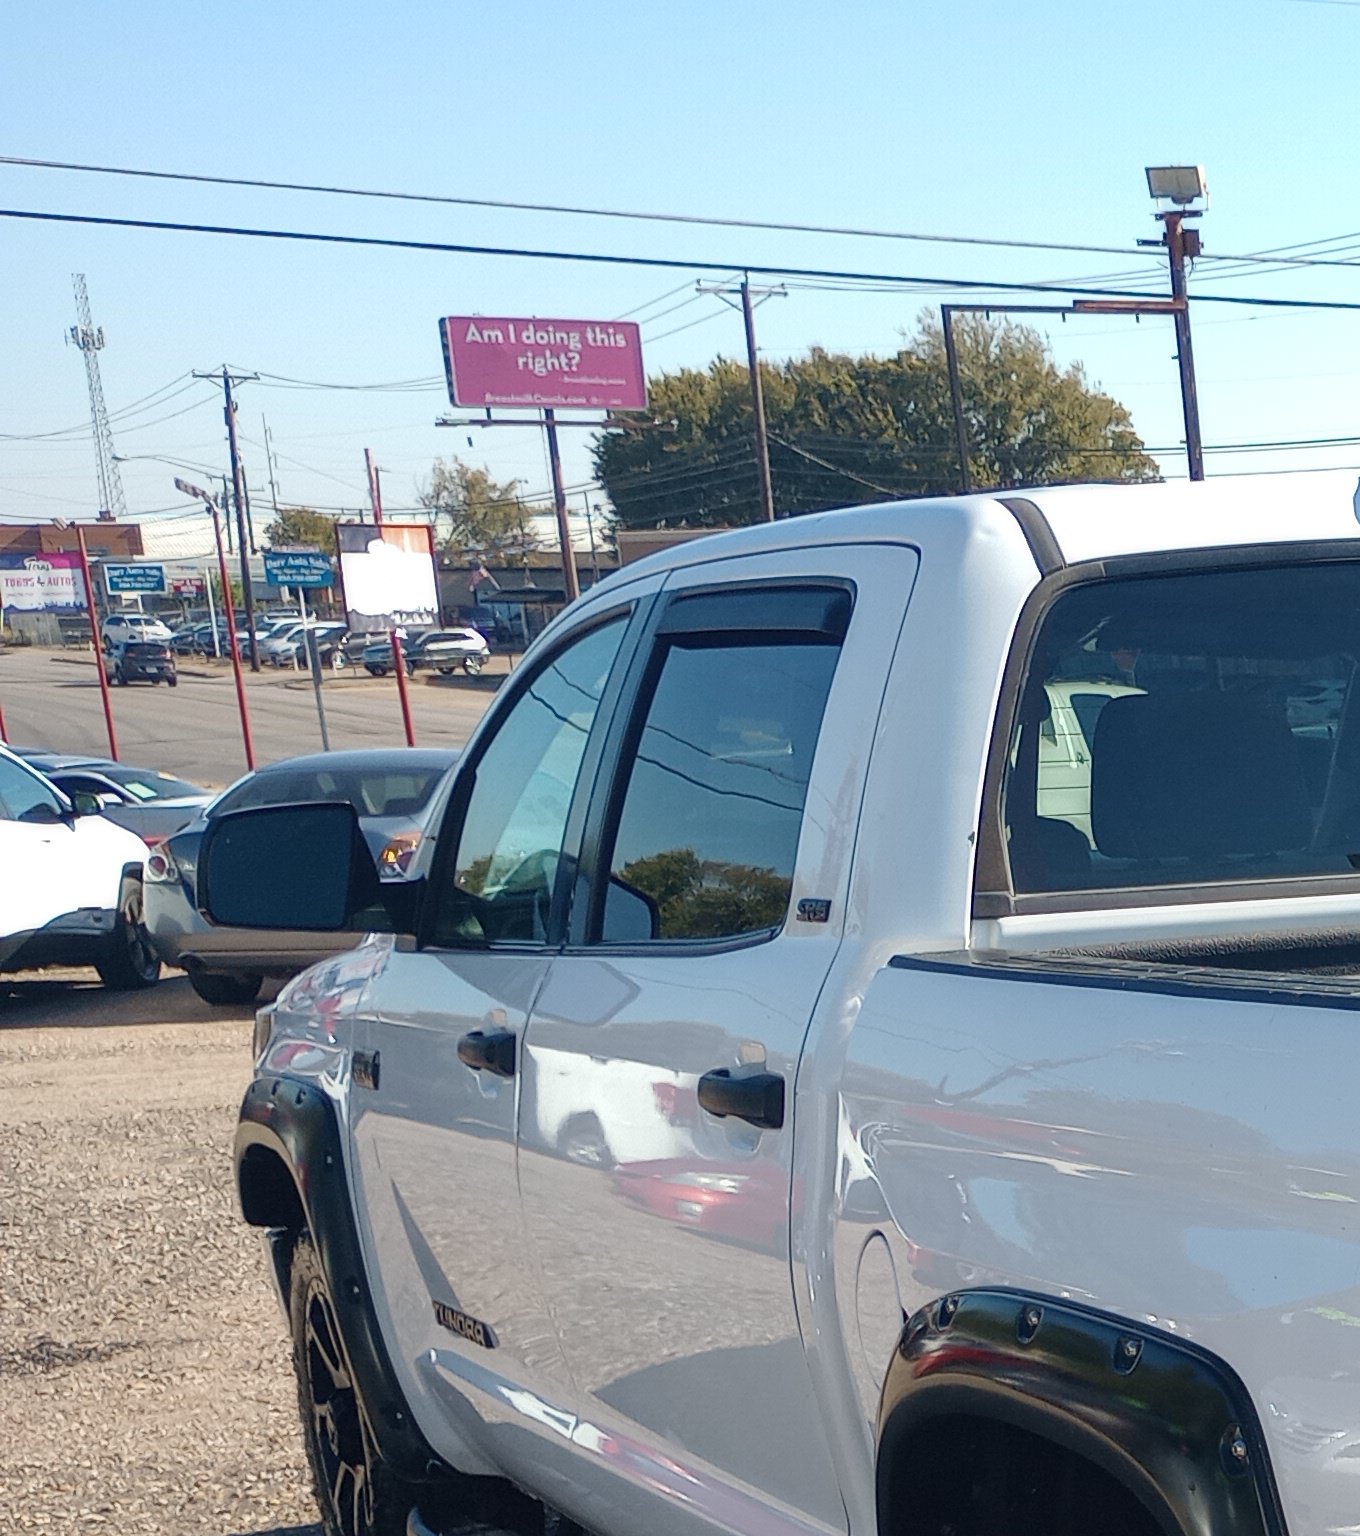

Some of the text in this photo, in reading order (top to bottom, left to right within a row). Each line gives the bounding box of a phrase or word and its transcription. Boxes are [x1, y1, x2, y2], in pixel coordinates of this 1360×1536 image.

[466, 322, 627, 351] Am I doing this
[517, 351, 581, 377] right?
